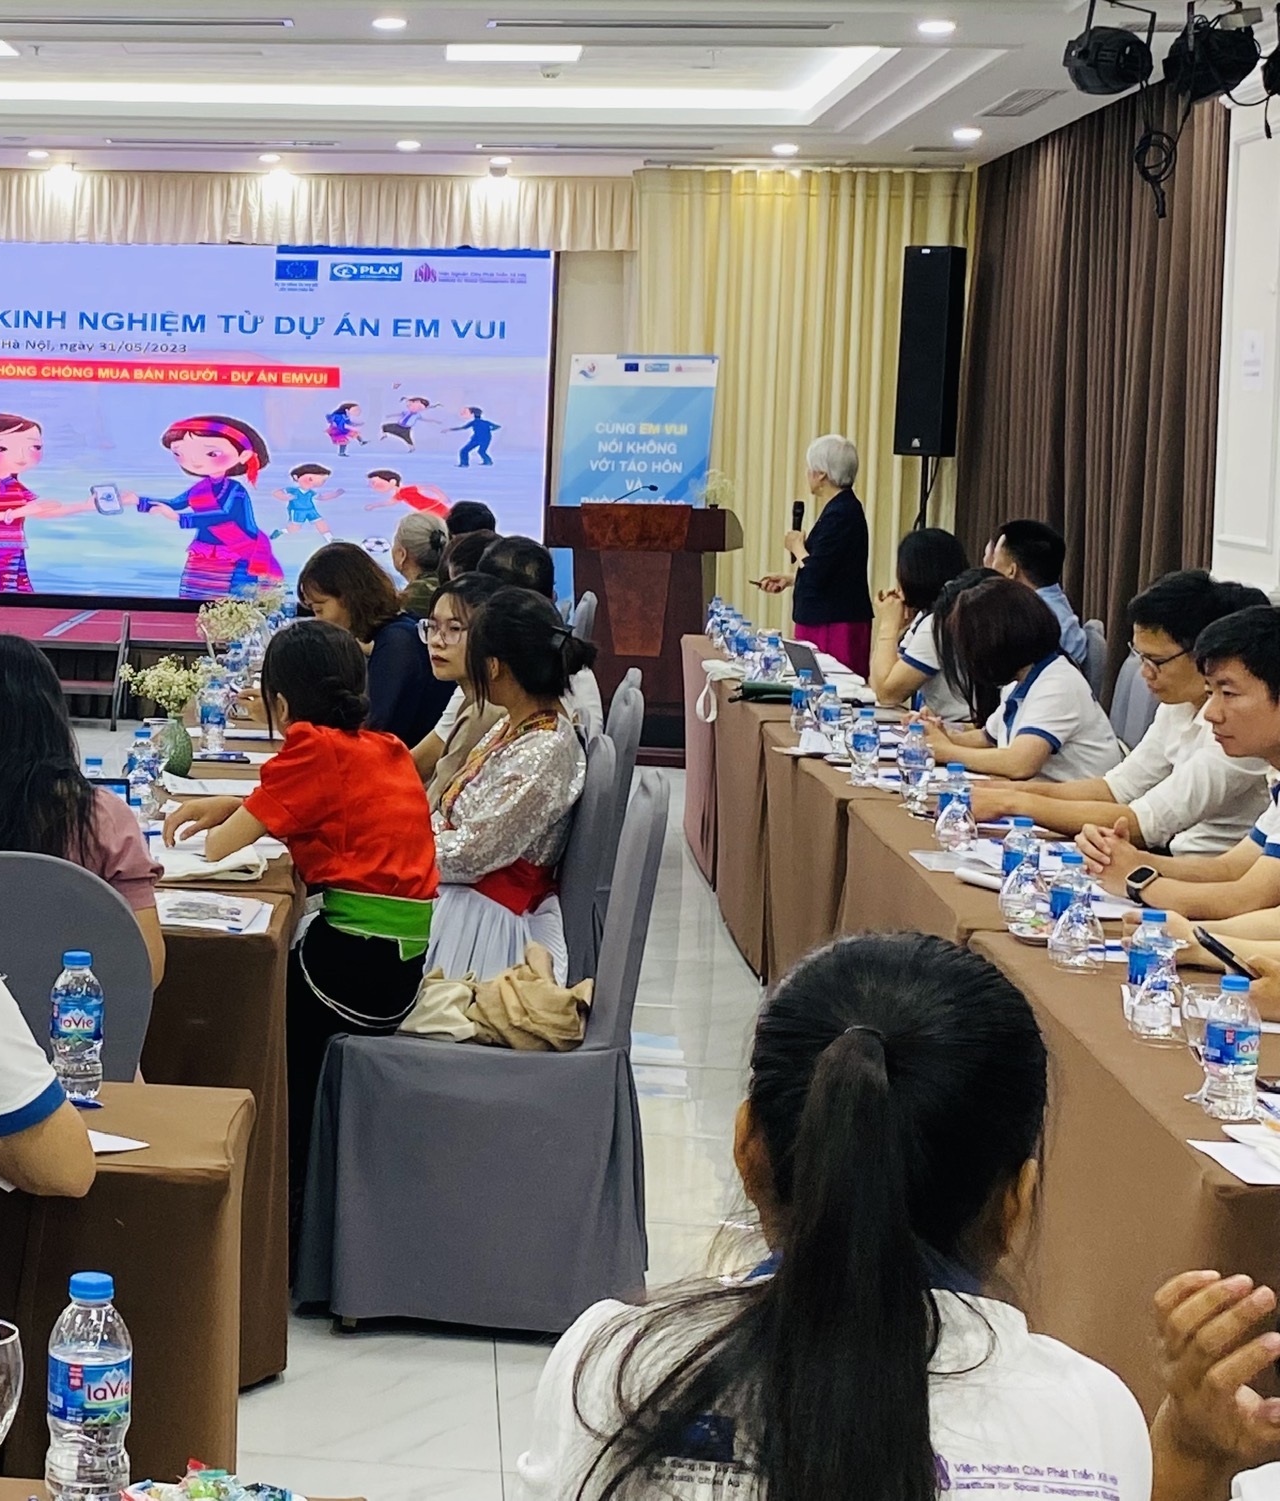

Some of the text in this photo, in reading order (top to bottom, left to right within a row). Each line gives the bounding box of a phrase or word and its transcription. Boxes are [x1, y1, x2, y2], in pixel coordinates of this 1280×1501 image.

[359, 265, 399, 275] PLAN
[78, 310, 206, 336] NGHIỆM
[217, 310, 264, 334] TỪ
[274, 315, 325, 340] DỰ
[333, 312, 380, 337] ÁN
[392, 318, 440, 338] EM
[450, 319, 506, 339] VUI
[0, 338, 20, 349] Hà
[59, 340, 95, 352] ngày
[99, 341, 187, 353] 31/05/2023
[98, 367, 130, 380] MUA
[134, 365, 164, 381] BÁN
[168, 366, 218, 382] NGƯỜI
[231, 369, 254, 385] DỰ
[256, 367, 278, 383] ÁN
[281, 371, 328, 385] EMVUI
[639, 422, 660, 435] EM
[664, 423, 688, 436] VUI
[598, 437, 677, 455] NÓI KHÔNG
[590, 456, 616, 472] VỚI
[651, 458, 683, 474] HÔN
